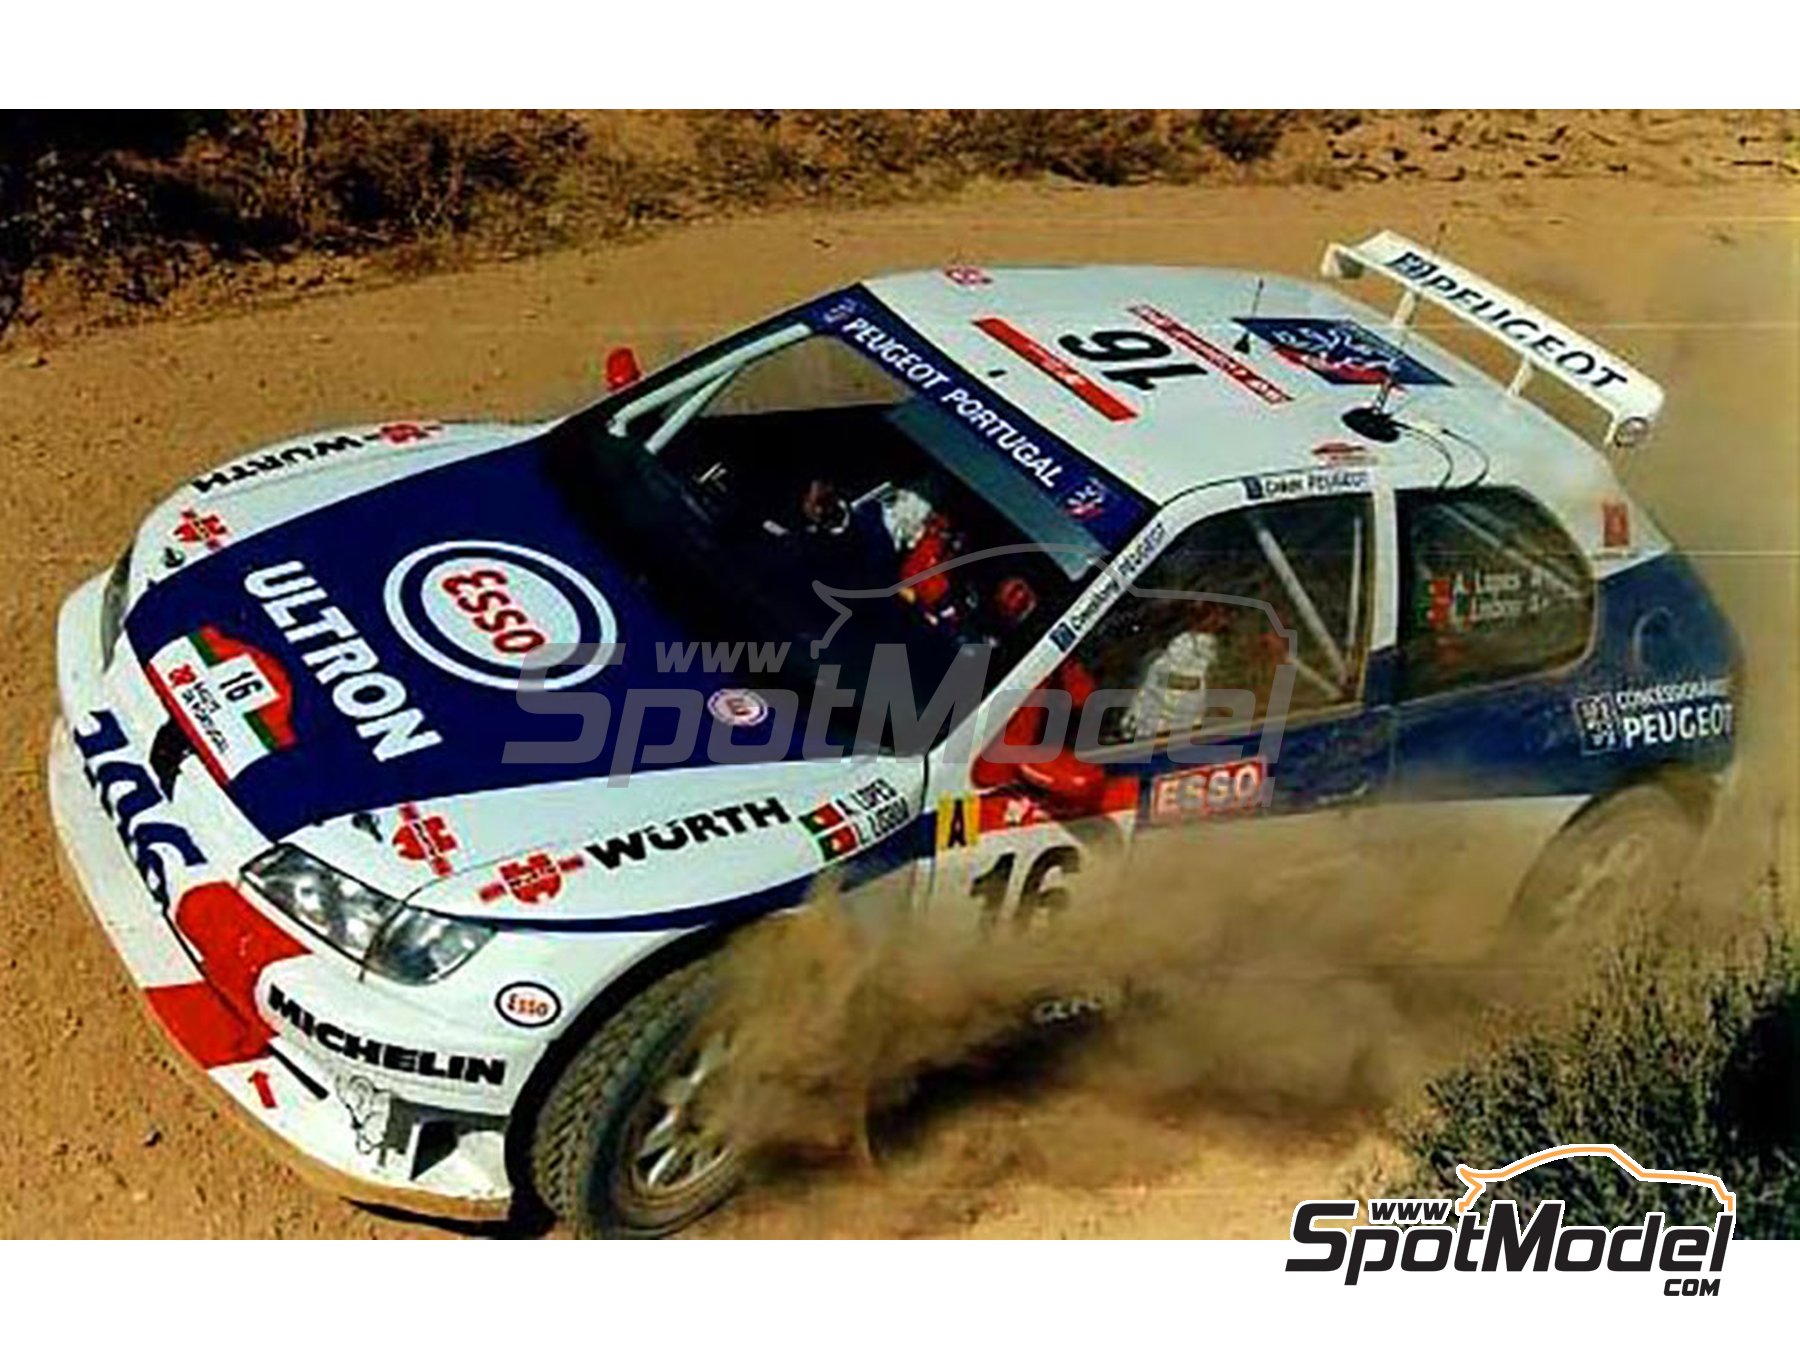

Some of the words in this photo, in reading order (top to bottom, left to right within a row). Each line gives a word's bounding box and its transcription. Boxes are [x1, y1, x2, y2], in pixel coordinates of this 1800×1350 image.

[1058, 329, 1208, 390] 16
[1427, 273, 1628, 388] PEUGEOT
[842, 317, 950, 389] PEUGEOT
[941, 387, 1064, 488] PORTUGAL
[441, 569, 546, 653] ESSO
[219, 671, 264, 702] 16
[244, 561, 443, 762] ULTRON
[1623, 703, 1733, 748] PEUGEOT
[948, 799, 967, 847] A
[1157, 764, 1261, 817] ESSO
[970, 846, 1080, 930] 16
[267, 983, 506, 1087] MICHELIN
[508, 992, 548, 1018] ESSO
